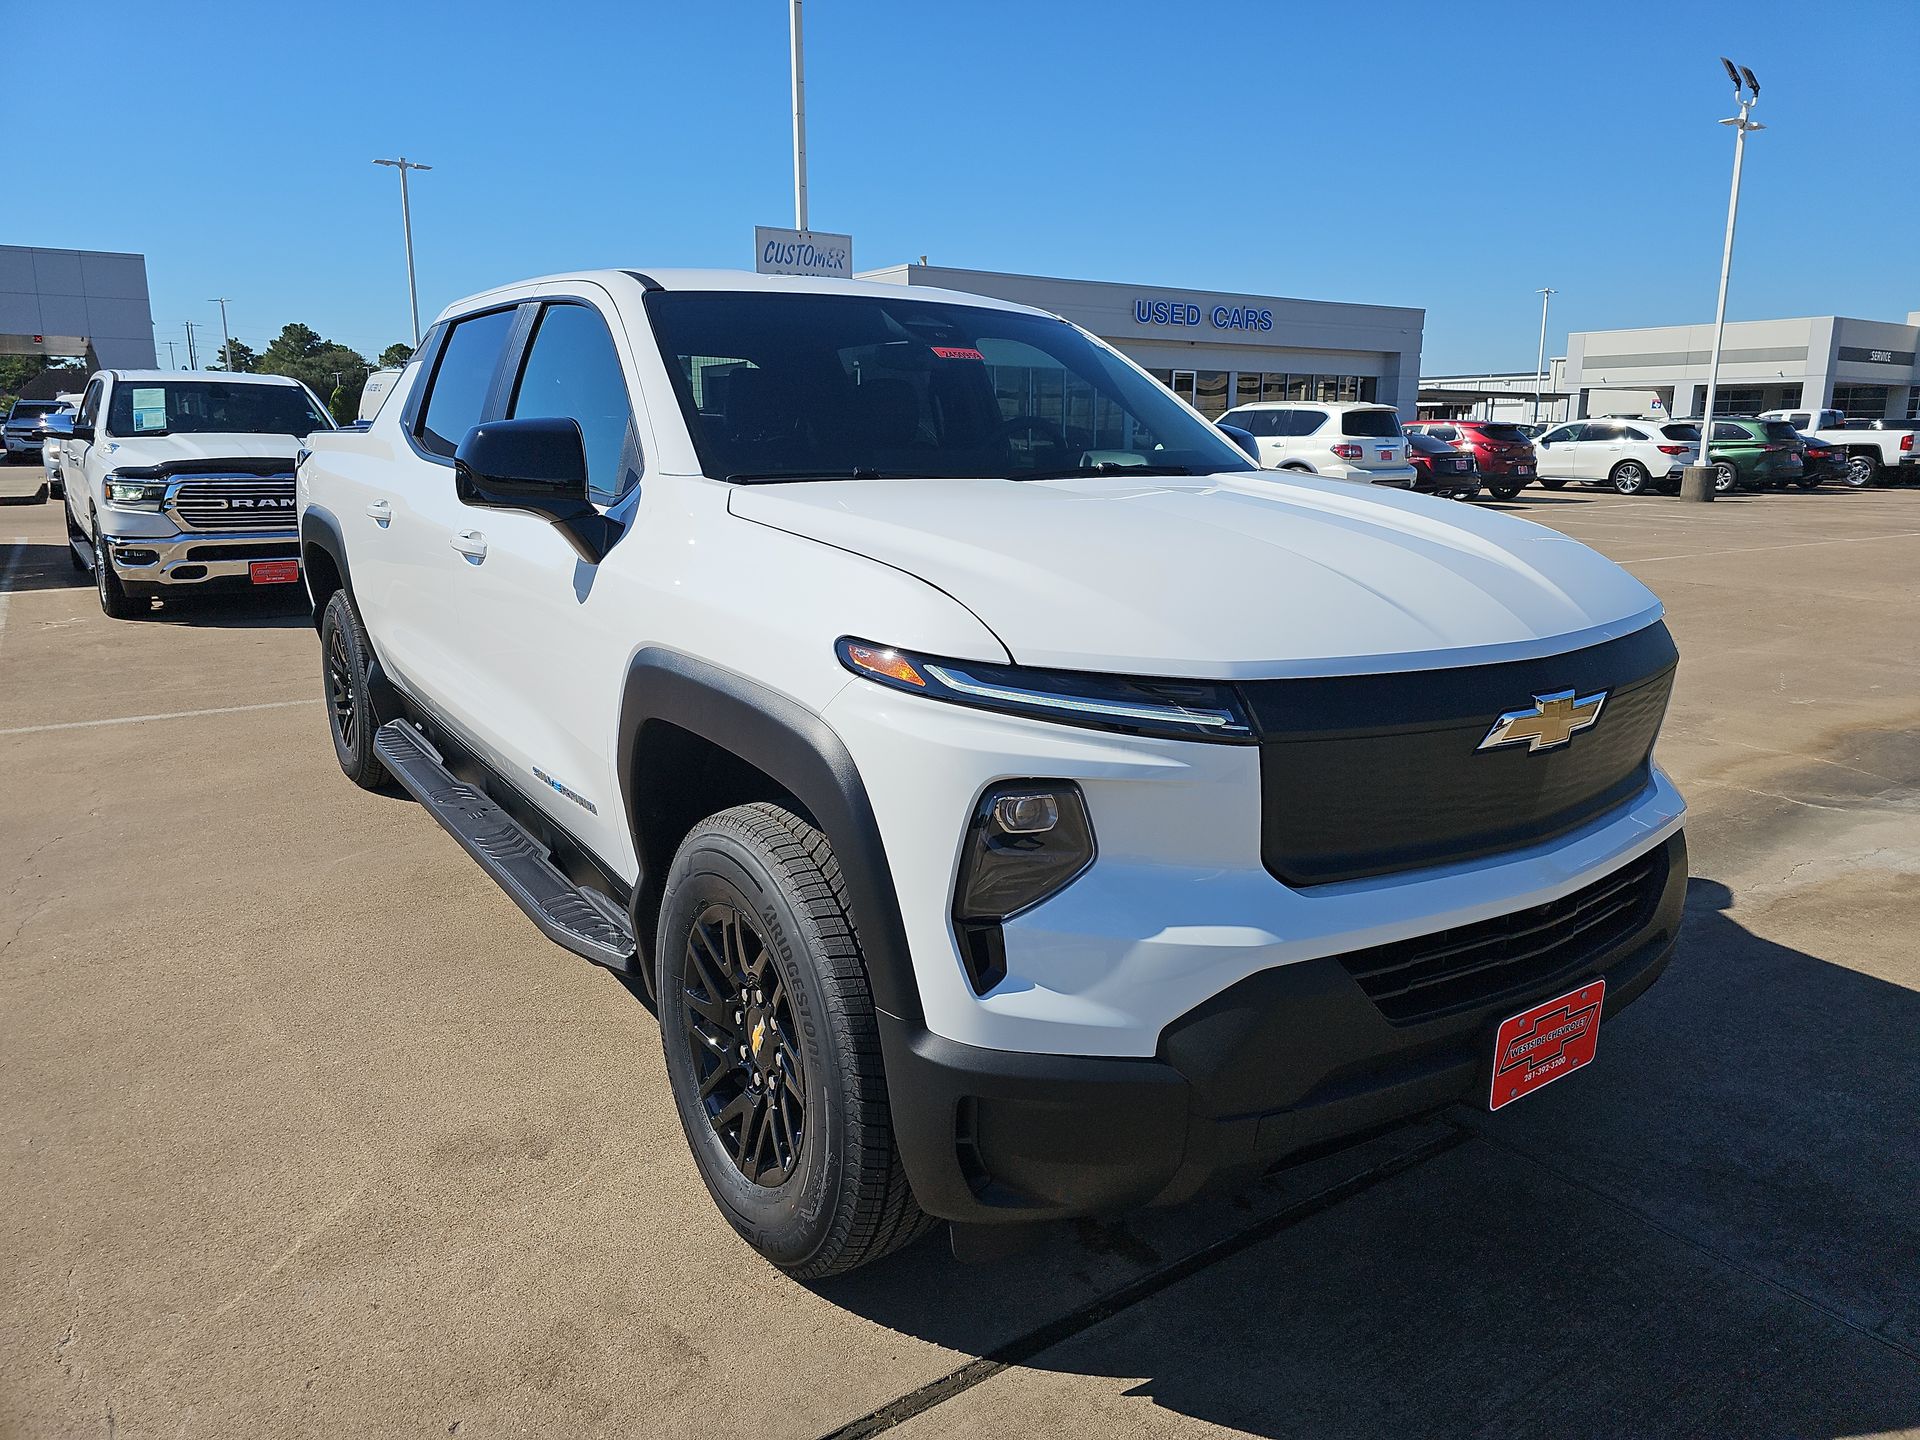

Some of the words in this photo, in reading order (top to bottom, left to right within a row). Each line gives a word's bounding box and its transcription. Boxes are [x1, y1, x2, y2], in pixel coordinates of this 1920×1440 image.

[763, 240, 845, 270] CUSTOMER
[1134, 300, 1201, 327] USED
[1212, 305, 1274, 332] CARS
[1871, 350, 1892, 362] SERVICE
[232, 499, 296, 508] RAM
[762, 904, 822, 1072] BRIDGESTONE
[1510, 1034, 1546, 1059] WESTSIDE
[1547, 1015, 1588, 1042] CHEVROLET
[1523, 1055, 1567, 1083] 281-392-3200
